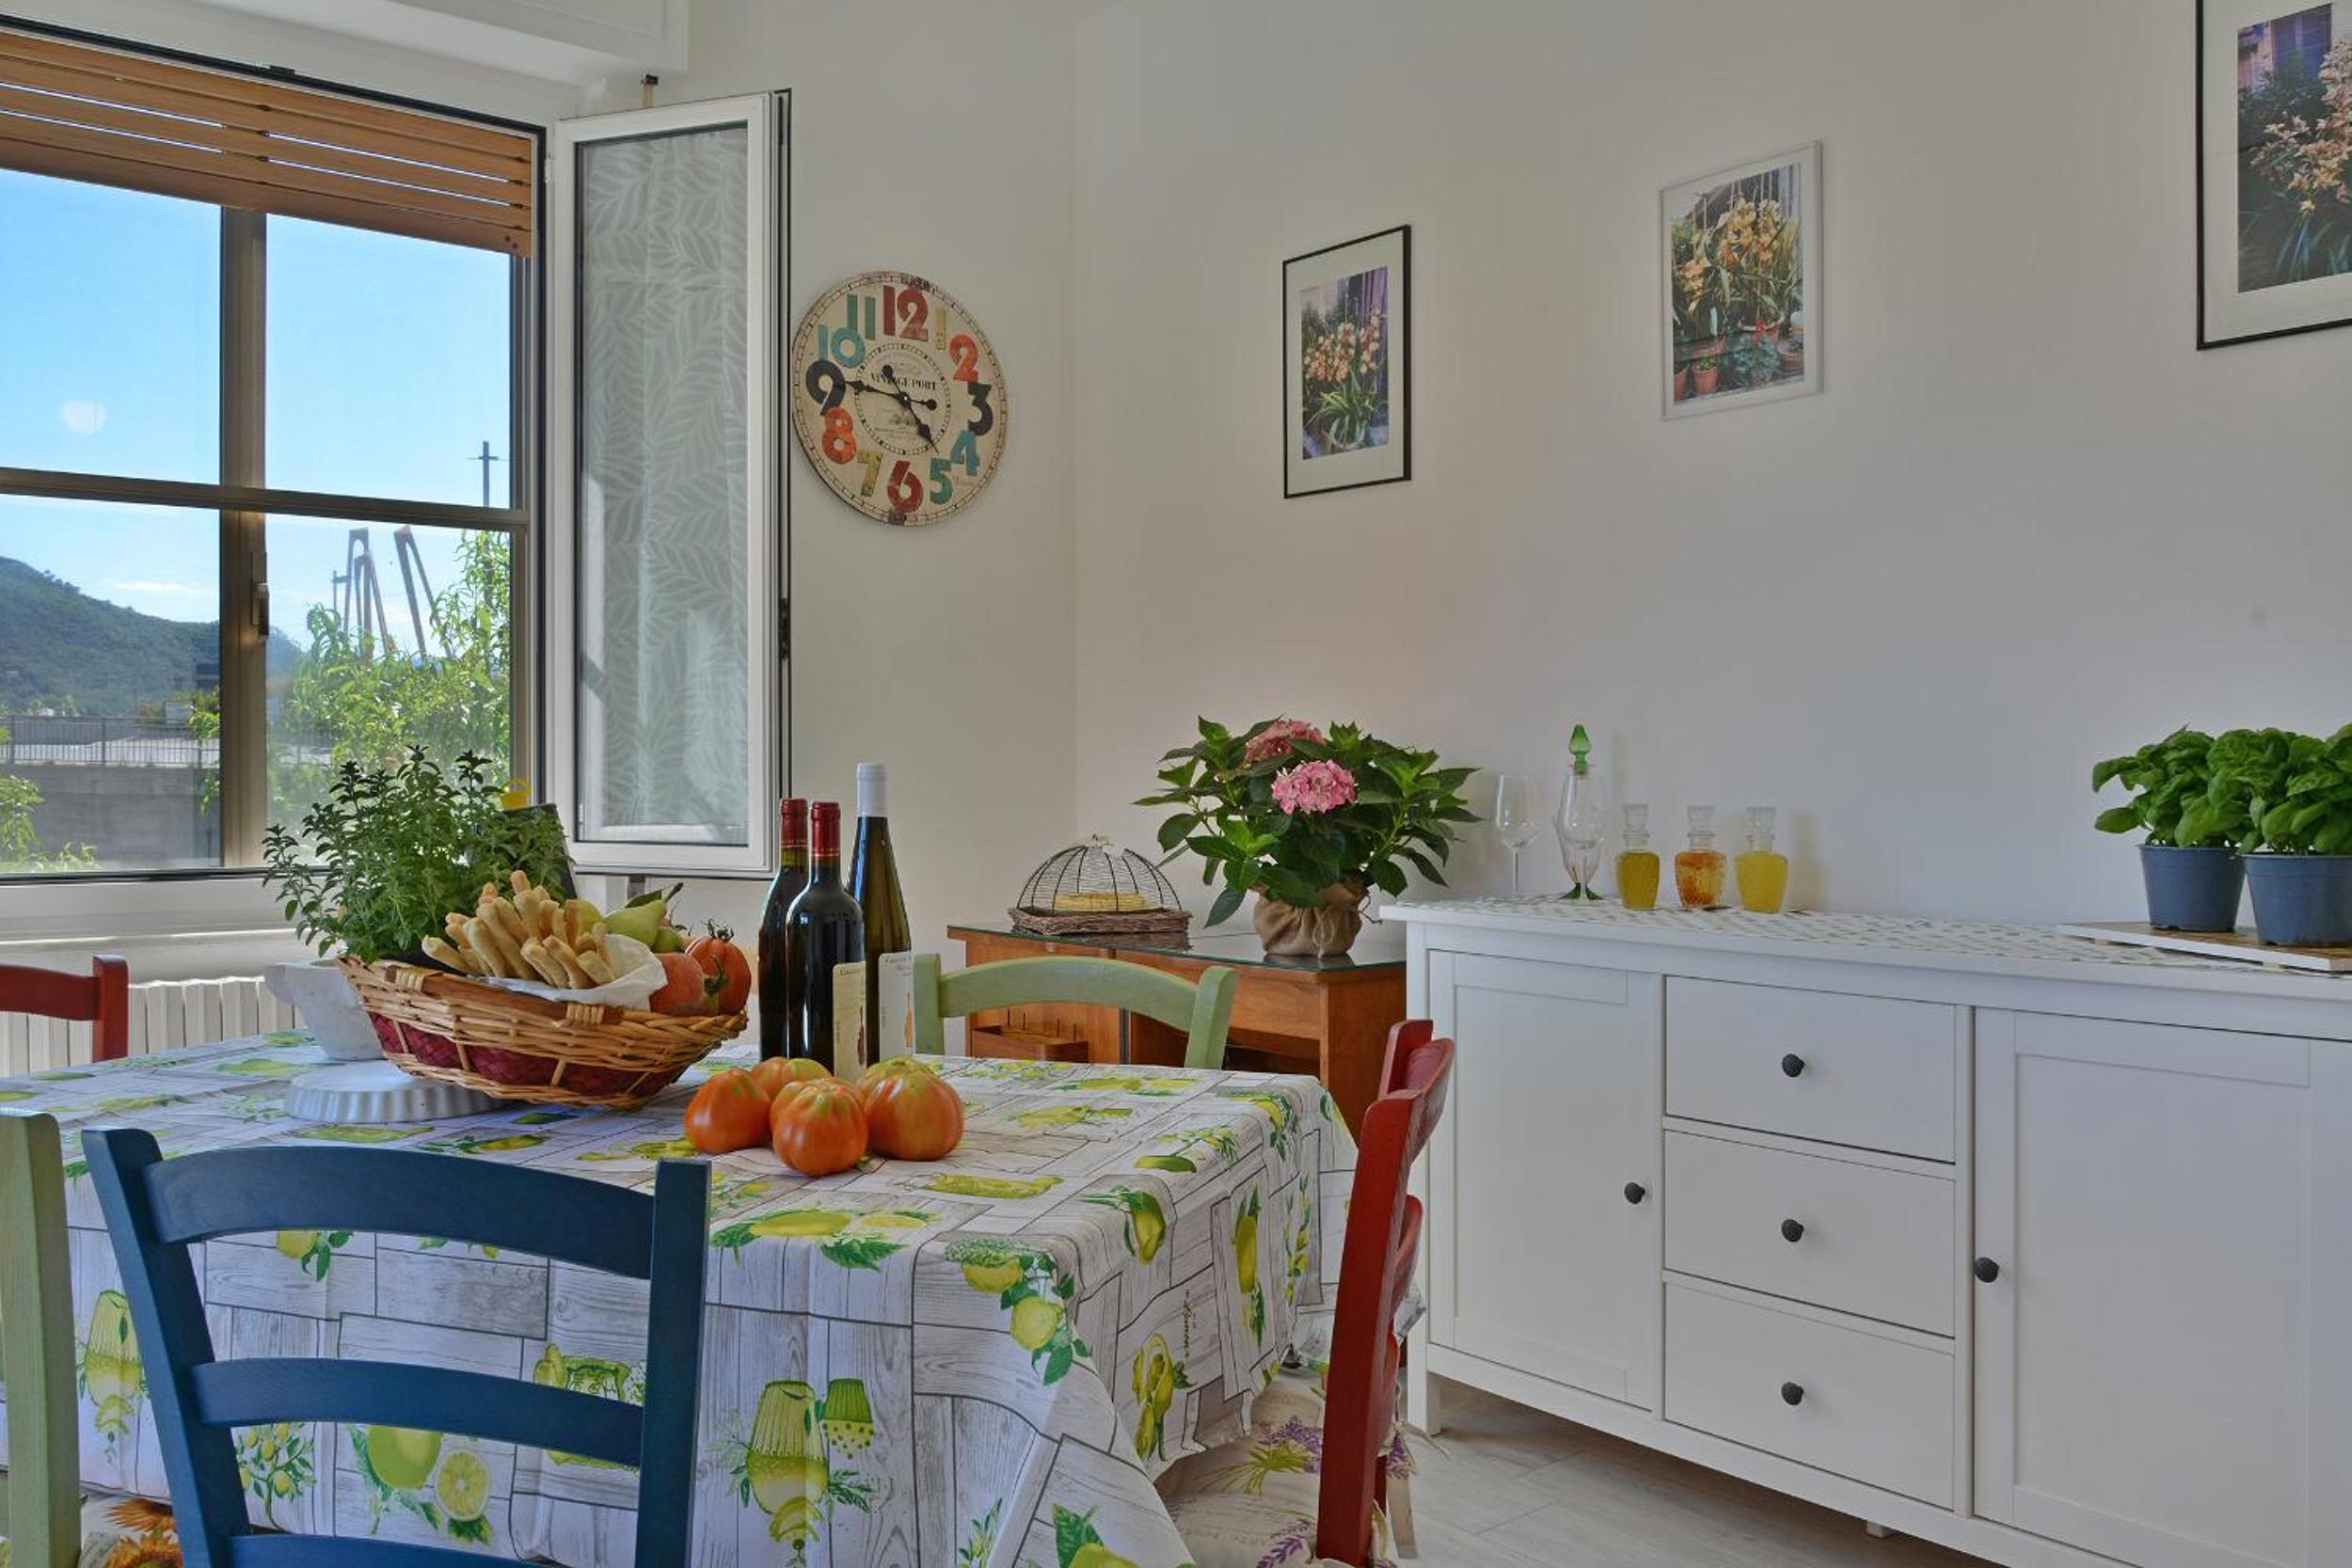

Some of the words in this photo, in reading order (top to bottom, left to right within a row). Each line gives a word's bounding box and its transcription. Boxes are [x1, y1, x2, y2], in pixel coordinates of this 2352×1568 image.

[847, 293, 876, 341] 11
[882, 285, 929, 342] 12
[935, 308, 947, 351] 1
[818, 325, 866, 369] 10
[949, 334, 979, 382] 2
[805, 359, 846, 416] 9
[871, 372, 910, 387] VINAGE
[967, 381, 993, 436] 3
[821, 406, 857, 465] 8
[950, 429, 980, 476] 4
[857, 449, 883, 497] 7
[887, 460, 924, 513] 6
[930, 457, 954, 505] 5
